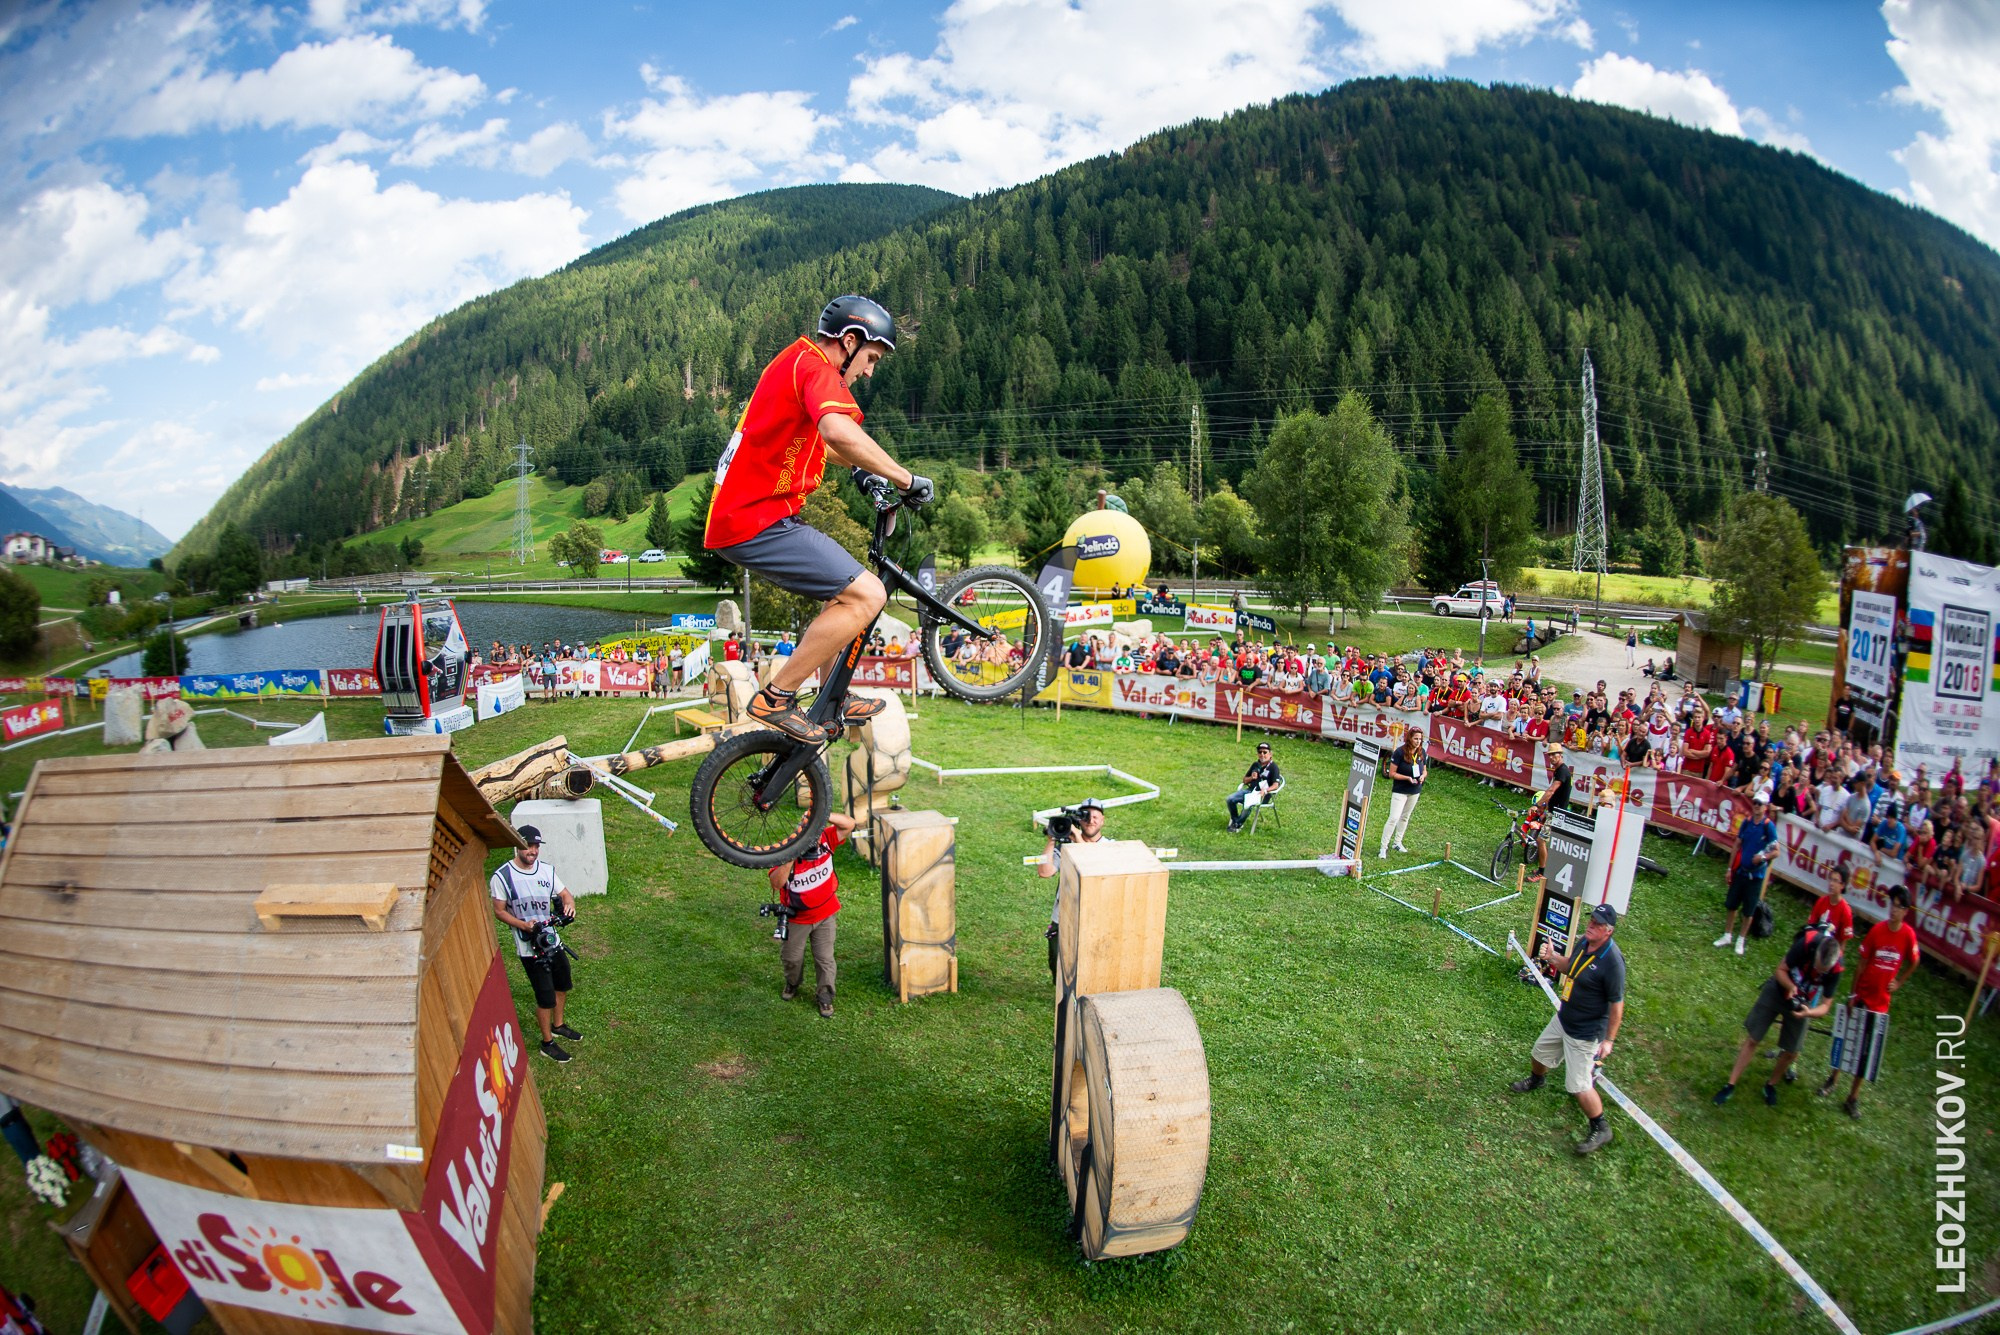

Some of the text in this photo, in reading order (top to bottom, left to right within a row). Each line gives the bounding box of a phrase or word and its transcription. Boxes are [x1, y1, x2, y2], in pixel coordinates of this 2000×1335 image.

[772, 437, 807, 496] SPAÑA
[921, 572, 934, 591] 3
[1042, 574, 1065, 604] 4
[1141, 602, 1181, 616] Melinda
[1189, 611, 1204, 625] Val
[1211, 612, 1234, 626] Sole
[1238, 611, 1272, 632] Melinda
[1851, 628, 1888, 667] 2017
[331, 673, 379, 690] Val di Sole
[528, 667, 544, 686] Va
[562, 666, 595, 685] Sole
[607, 667, 628, 686] Val
[628, 674, 638, 686] di
[865, 668, 875, 681] di
[875, 661, 910, 683] Sole
[1072, 673, 1099, 686] WD-40
[1943, 661, 1982, 693] 2016
[1118, 679, 1207, 711] Val di Sole
[1224, 689, 1314, 725] Val di Sole
[1331, 704, 1409, 743] Val di Sol
[1438, 724, 1466, 754] Val
[1465, 745, 1480, 760] di
[1479, 736, 1523, 774] Sole
[1352, 759, 1375, 777] START
[1352, 778, 1365, 804] 4
[1574, 775, 1590, 793] di
[1667, 782, 1702, 822] Val
[1701, 808, 1718, 828] di
[1550, 836, 1590, 862] FINISH
[1786, 823, 1818, 874] Val
[1816, 857, 1834, 881] di
[793, 867, 829, 888] PHOTO
[1555, 863, 1573, 893] 4
[516, 901, 528, 914] TV
[1554, 902, 1568, 914] UCI
[1915, 882, 1952, 939] Val
[1946, 921, 1968, 949] di
[1547, 928, 1560, 940] UCI
[439, 1022, 519, 1272] Val di Sole
[173, 1212, 417, 1316] di Sole
